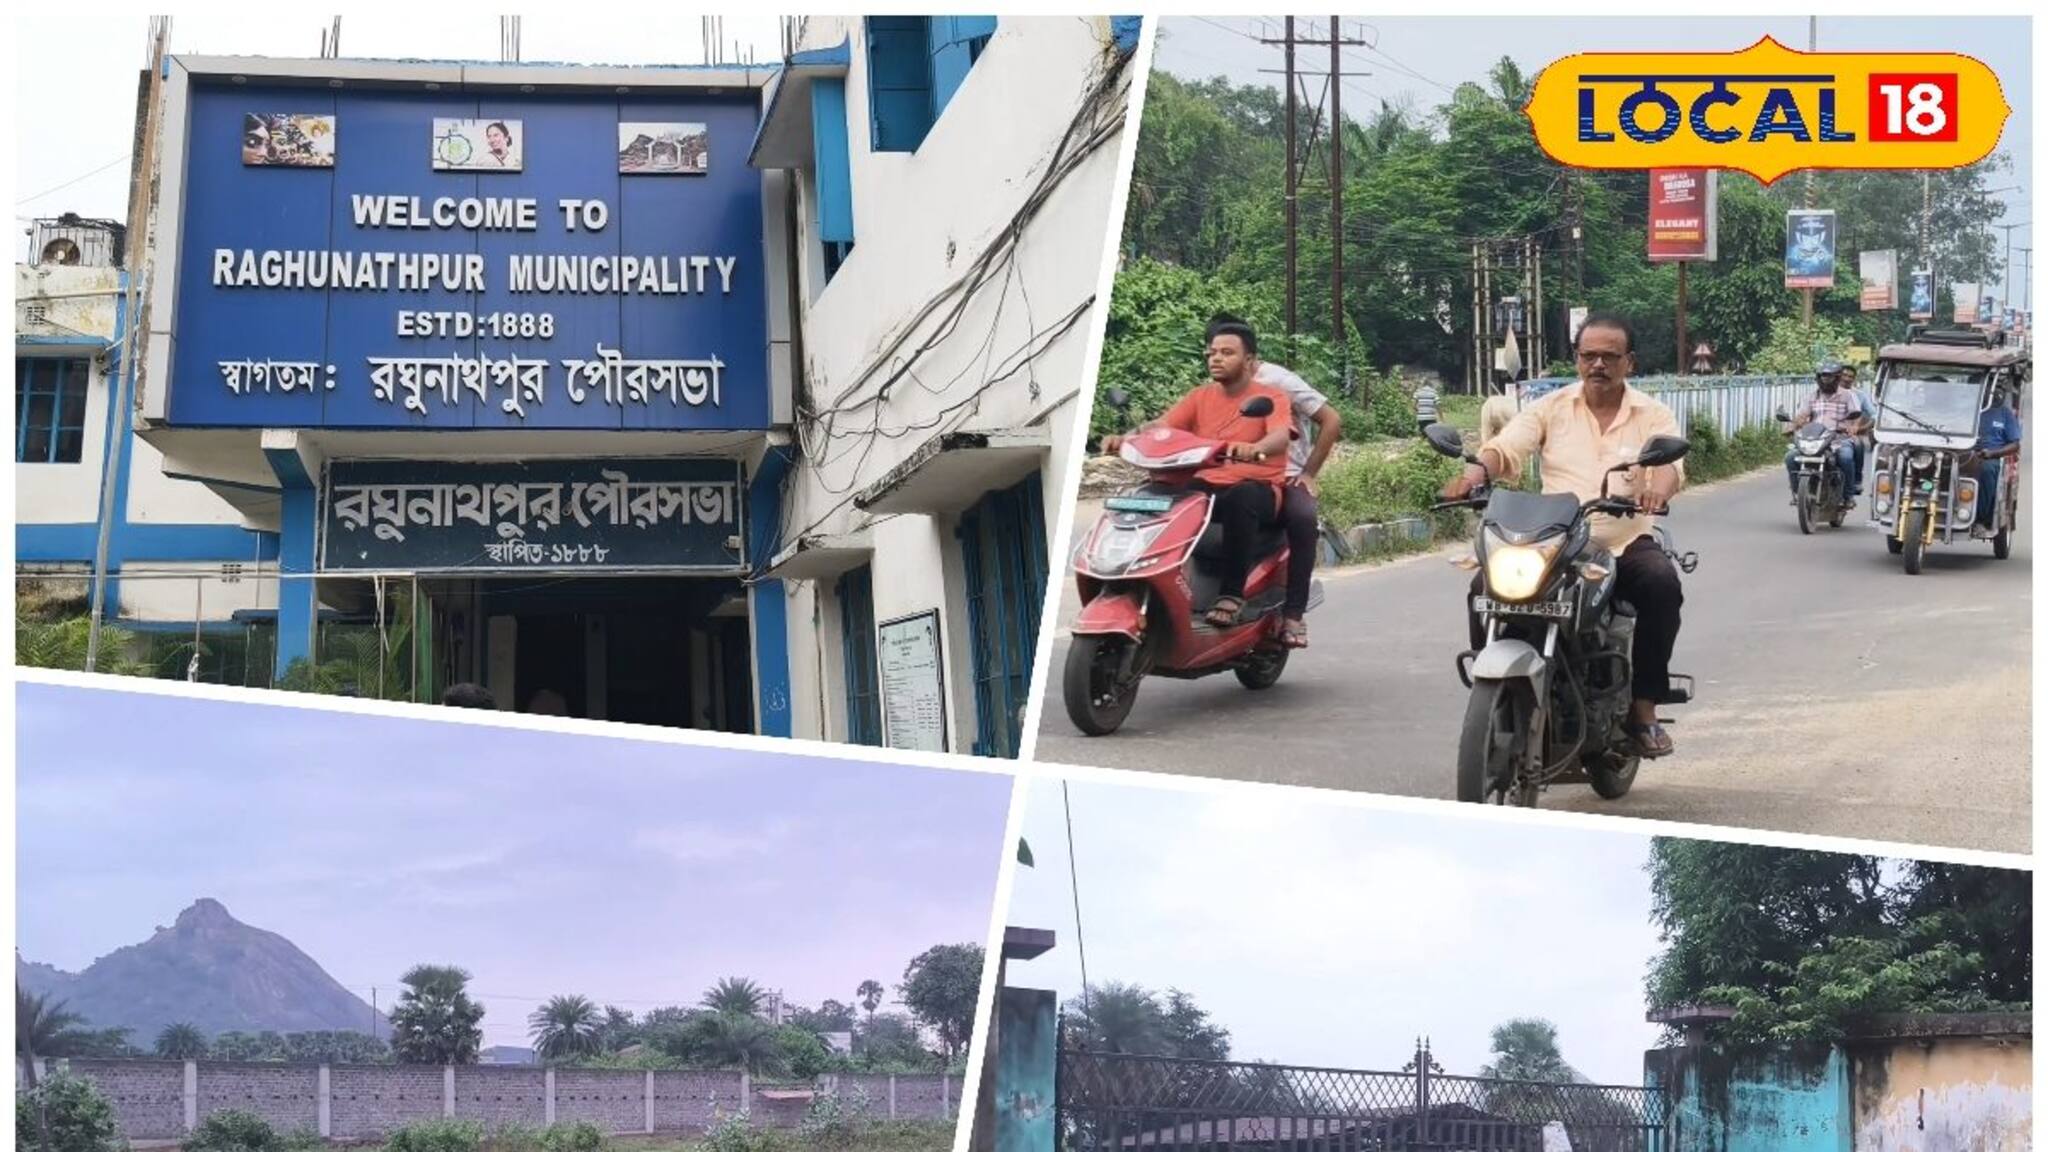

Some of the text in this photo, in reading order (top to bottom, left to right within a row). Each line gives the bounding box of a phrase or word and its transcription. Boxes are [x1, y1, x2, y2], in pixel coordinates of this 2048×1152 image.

[352, 194, 609, 230] WELCOME TO
[213, 249, 737, 293] RAGHUNATHPUR MUNICIPALITY
[397, 310, 555, 338] ESTD:1888
[367, 350, 551, 417] রঘুনাথপুর
[561, 342, 724, 406] পৌরসভা
[334, 470, 738, 544] রঘুনাথপুর পৌরসভা
[485, 542, 610, 565] স্থাপিত-১৮৮৮
